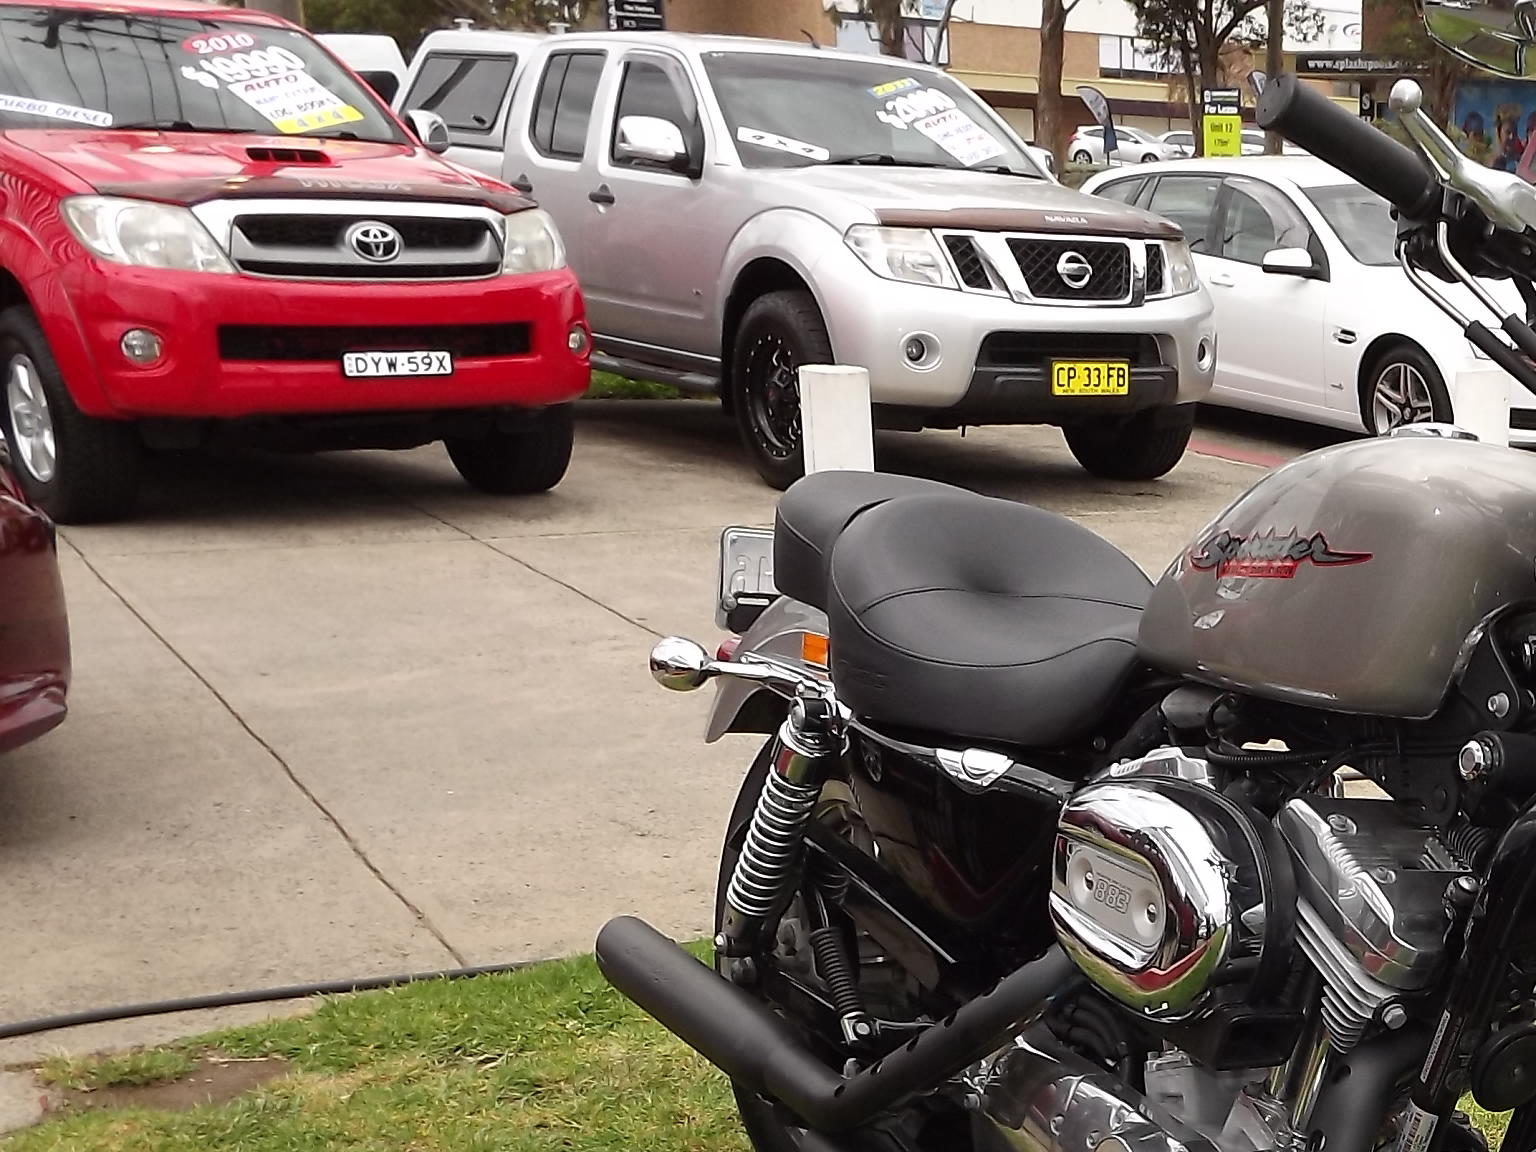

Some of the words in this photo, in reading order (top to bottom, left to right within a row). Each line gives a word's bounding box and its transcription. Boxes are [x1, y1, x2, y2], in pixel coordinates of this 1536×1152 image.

[192, 33, 255, 54] 2010
[243, 74, 298, 93] AUTO
[1205, 103, 1217, 114] For
[1044, 215, 1088, 224] NAVARA
[1094, 878, 1132, 914] 883
